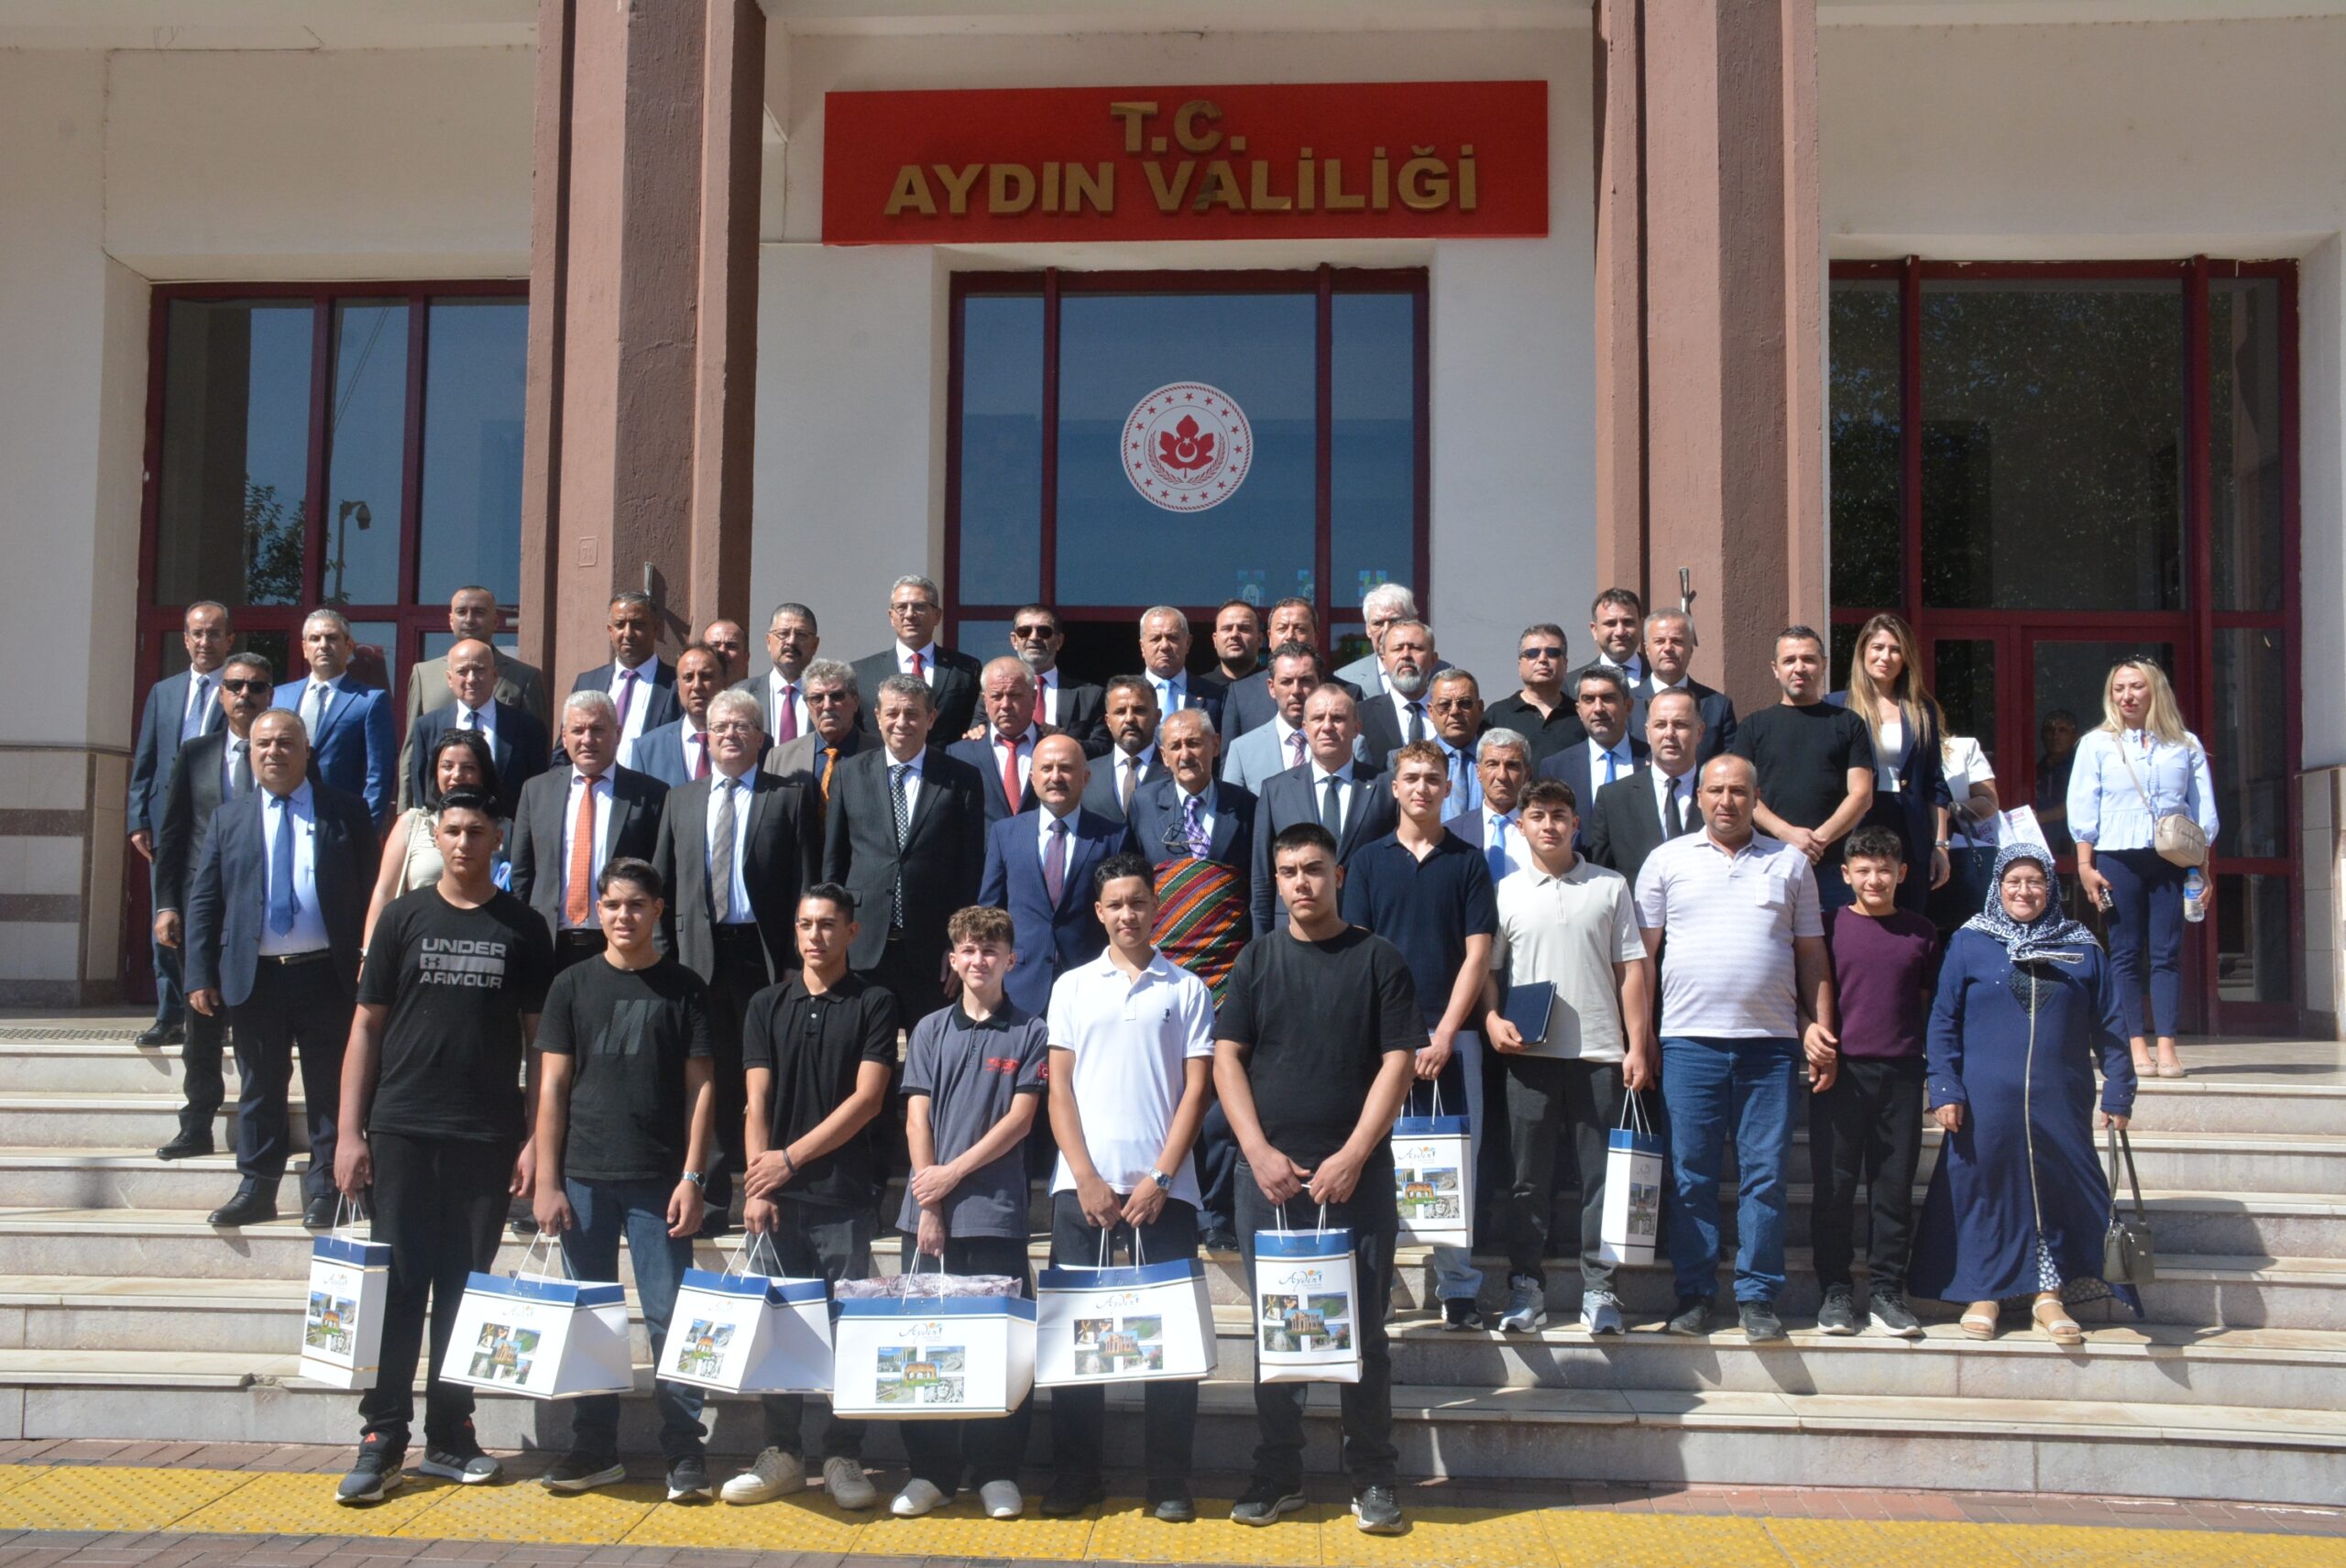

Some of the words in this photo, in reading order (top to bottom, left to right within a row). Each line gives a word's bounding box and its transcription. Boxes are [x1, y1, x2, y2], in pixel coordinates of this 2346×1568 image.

[1110, 99, 1246, 152] T.C.
[882, 160, 1115, 215] AYDIN
[1142, 143, 1477, 212] VALİLİĞİ
[422, 938, 506, 958] UNDER
[419, 971, 502, 989] ARMOUR
